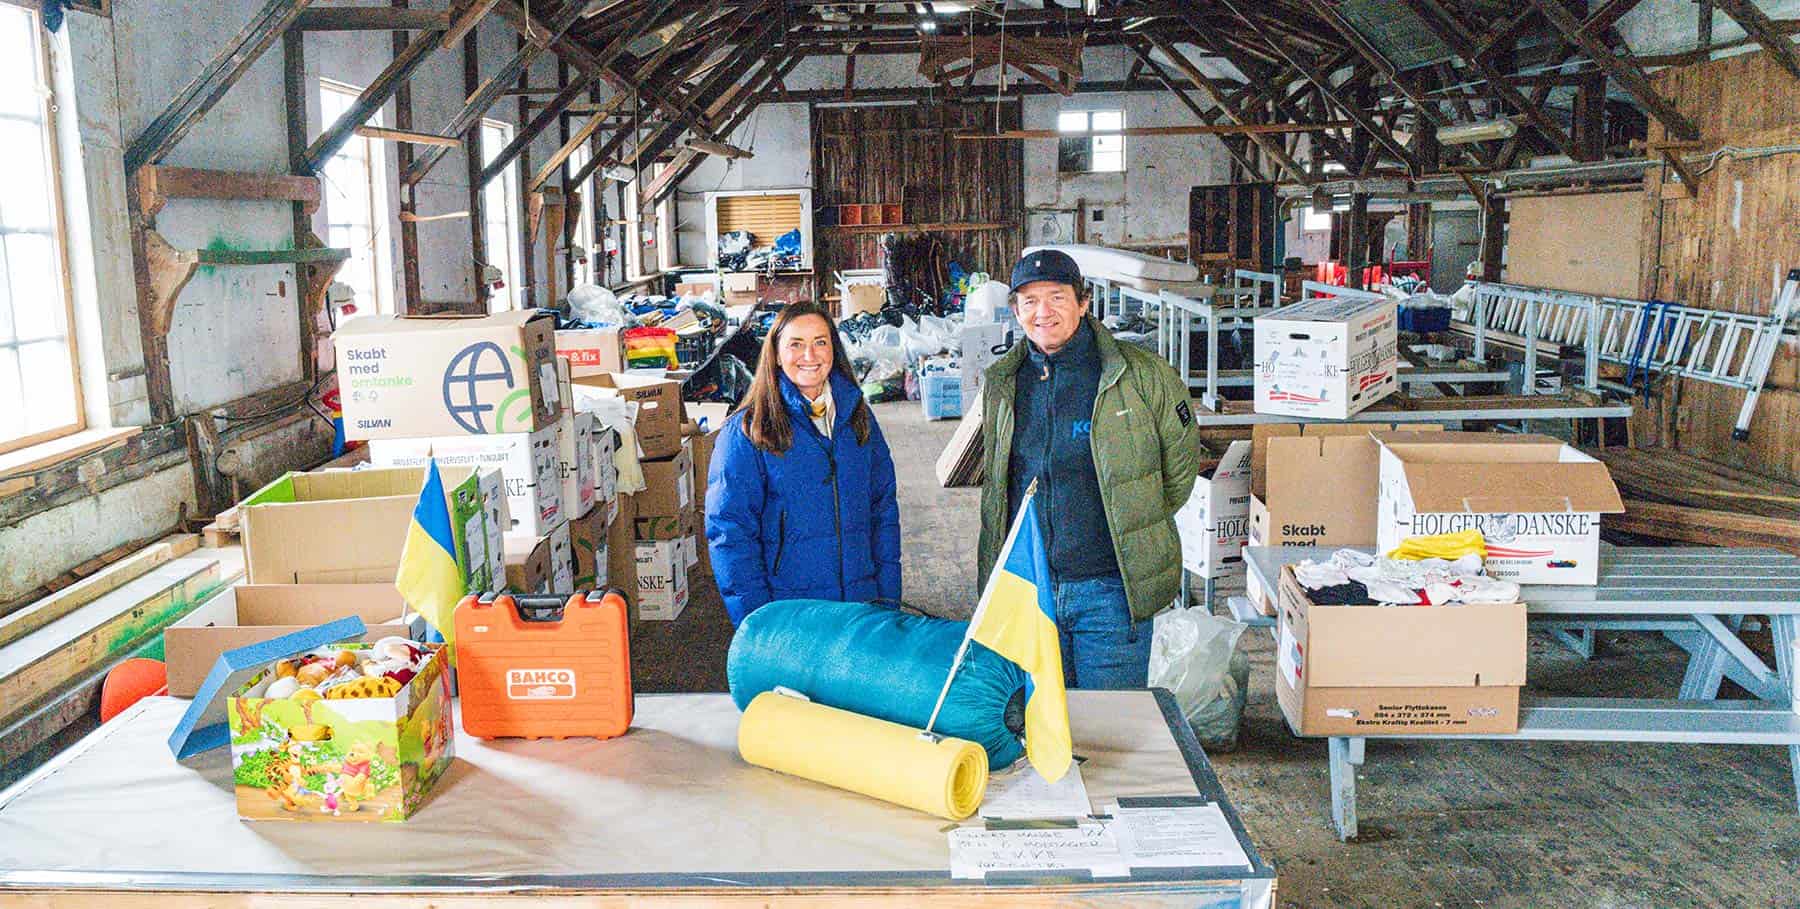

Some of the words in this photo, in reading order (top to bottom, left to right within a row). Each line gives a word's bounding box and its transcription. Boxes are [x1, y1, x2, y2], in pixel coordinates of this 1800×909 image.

[346, 348, 387, 360] Skabt
[571, 352, 580, 361] &
[582, 351, 598, 361] fix
[349, 362, 380, 375] med
[636, 388, 662, 400] SILVAN
[357, 419, 392, 429] SILVAN
[1282, 524, 1327, 537] Skabt
[1411, 514, 1486, 536] HOLGER
[1516, 513, 1590, 536] DANSKE
[511, 671, 570, 683] BAHCO
